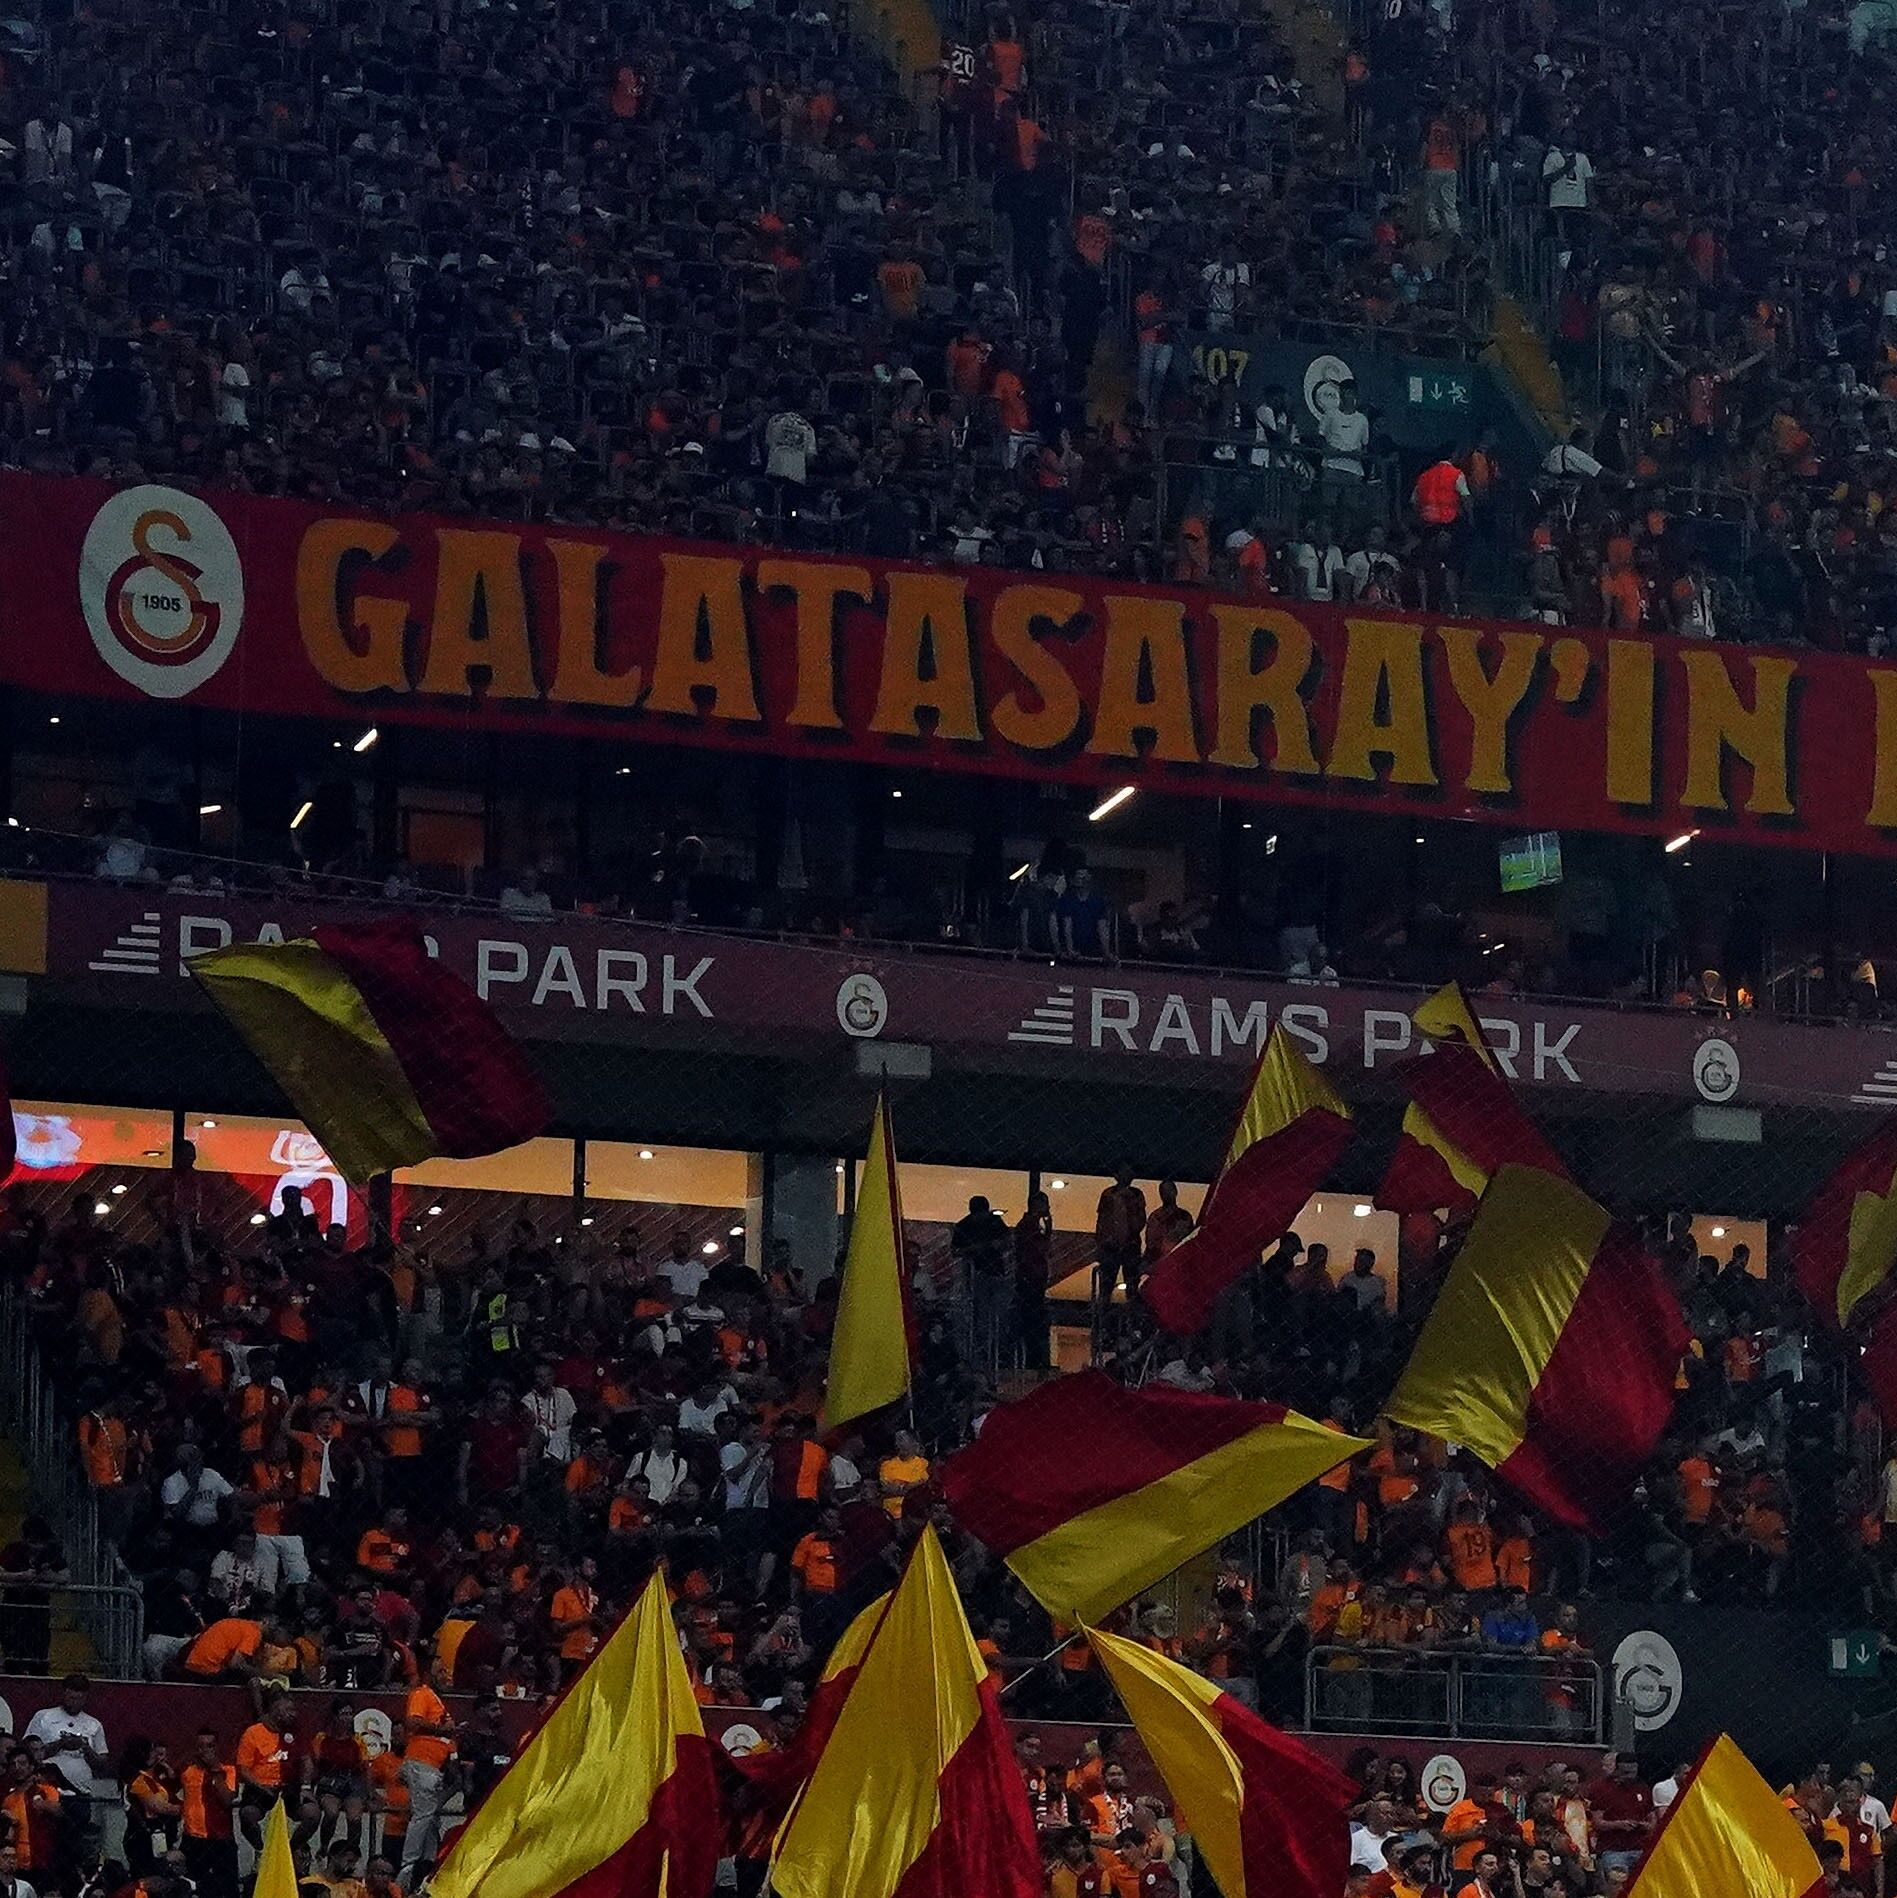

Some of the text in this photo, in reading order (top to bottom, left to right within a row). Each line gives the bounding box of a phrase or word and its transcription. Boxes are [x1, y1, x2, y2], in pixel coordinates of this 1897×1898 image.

[141, 594, 183, 613] 1905
[294, 517, 1798, 815] GALATASARAY'IN
[477, 940, 717, 1018] PARK
[1090, 988, 1329, 1064] RAMS
